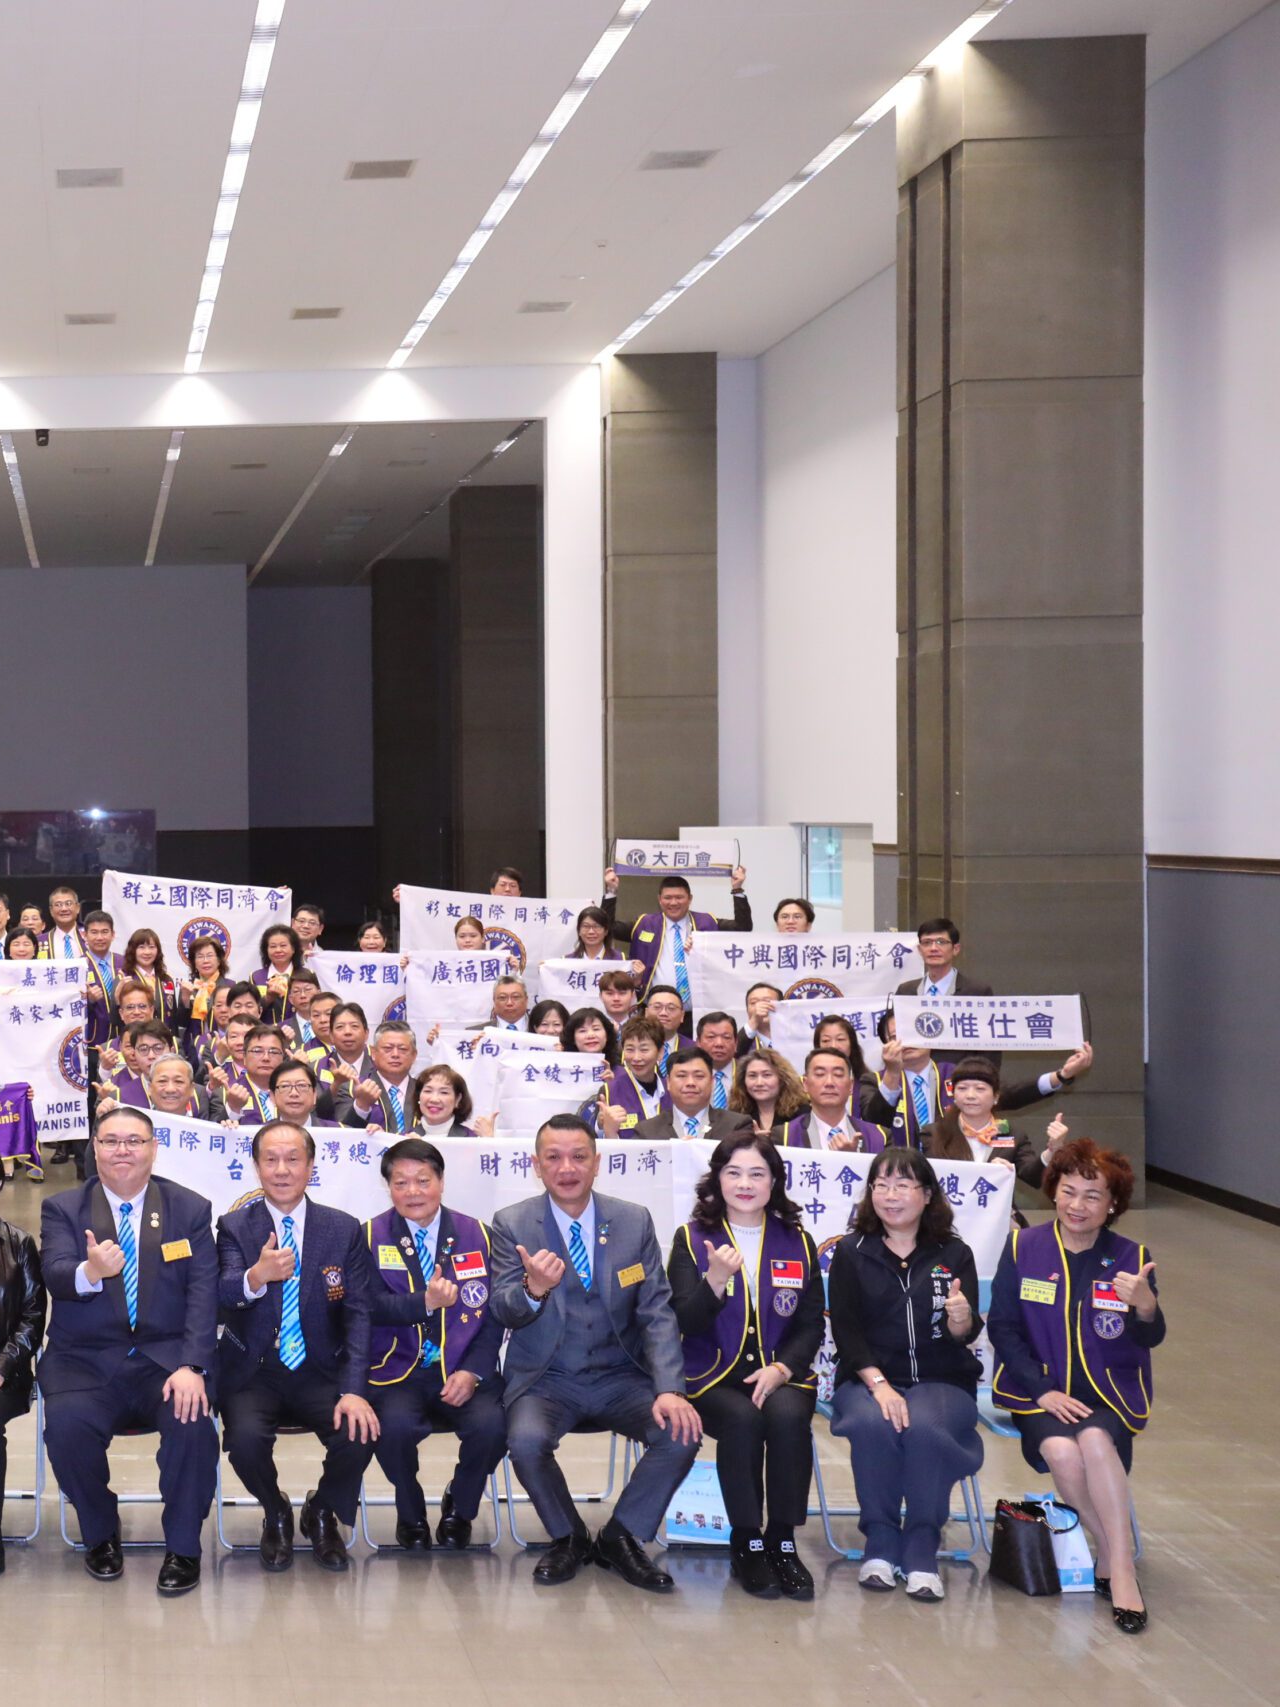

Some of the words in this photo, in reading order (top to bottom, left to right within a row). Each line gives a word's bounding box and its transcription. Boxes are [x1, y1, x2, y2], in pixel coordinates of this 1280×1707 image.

[652, 850, 712, 868] 大同會
[121, 881, 285, 912] 群立國際同濟會
[425, 899, 575, 926] 彩虹國際同濟會
[188, 921, 222, 936] KIWANIS
[723, 942, 914, 971] 中興國際同濟會
[431, 957, 517, 985] 廣福國
[793, 982, 835, 998] KIWANIS
[949, 1011, 1055, 1040] 惟仕會
[47, 1100, 82, 1115] HOME
